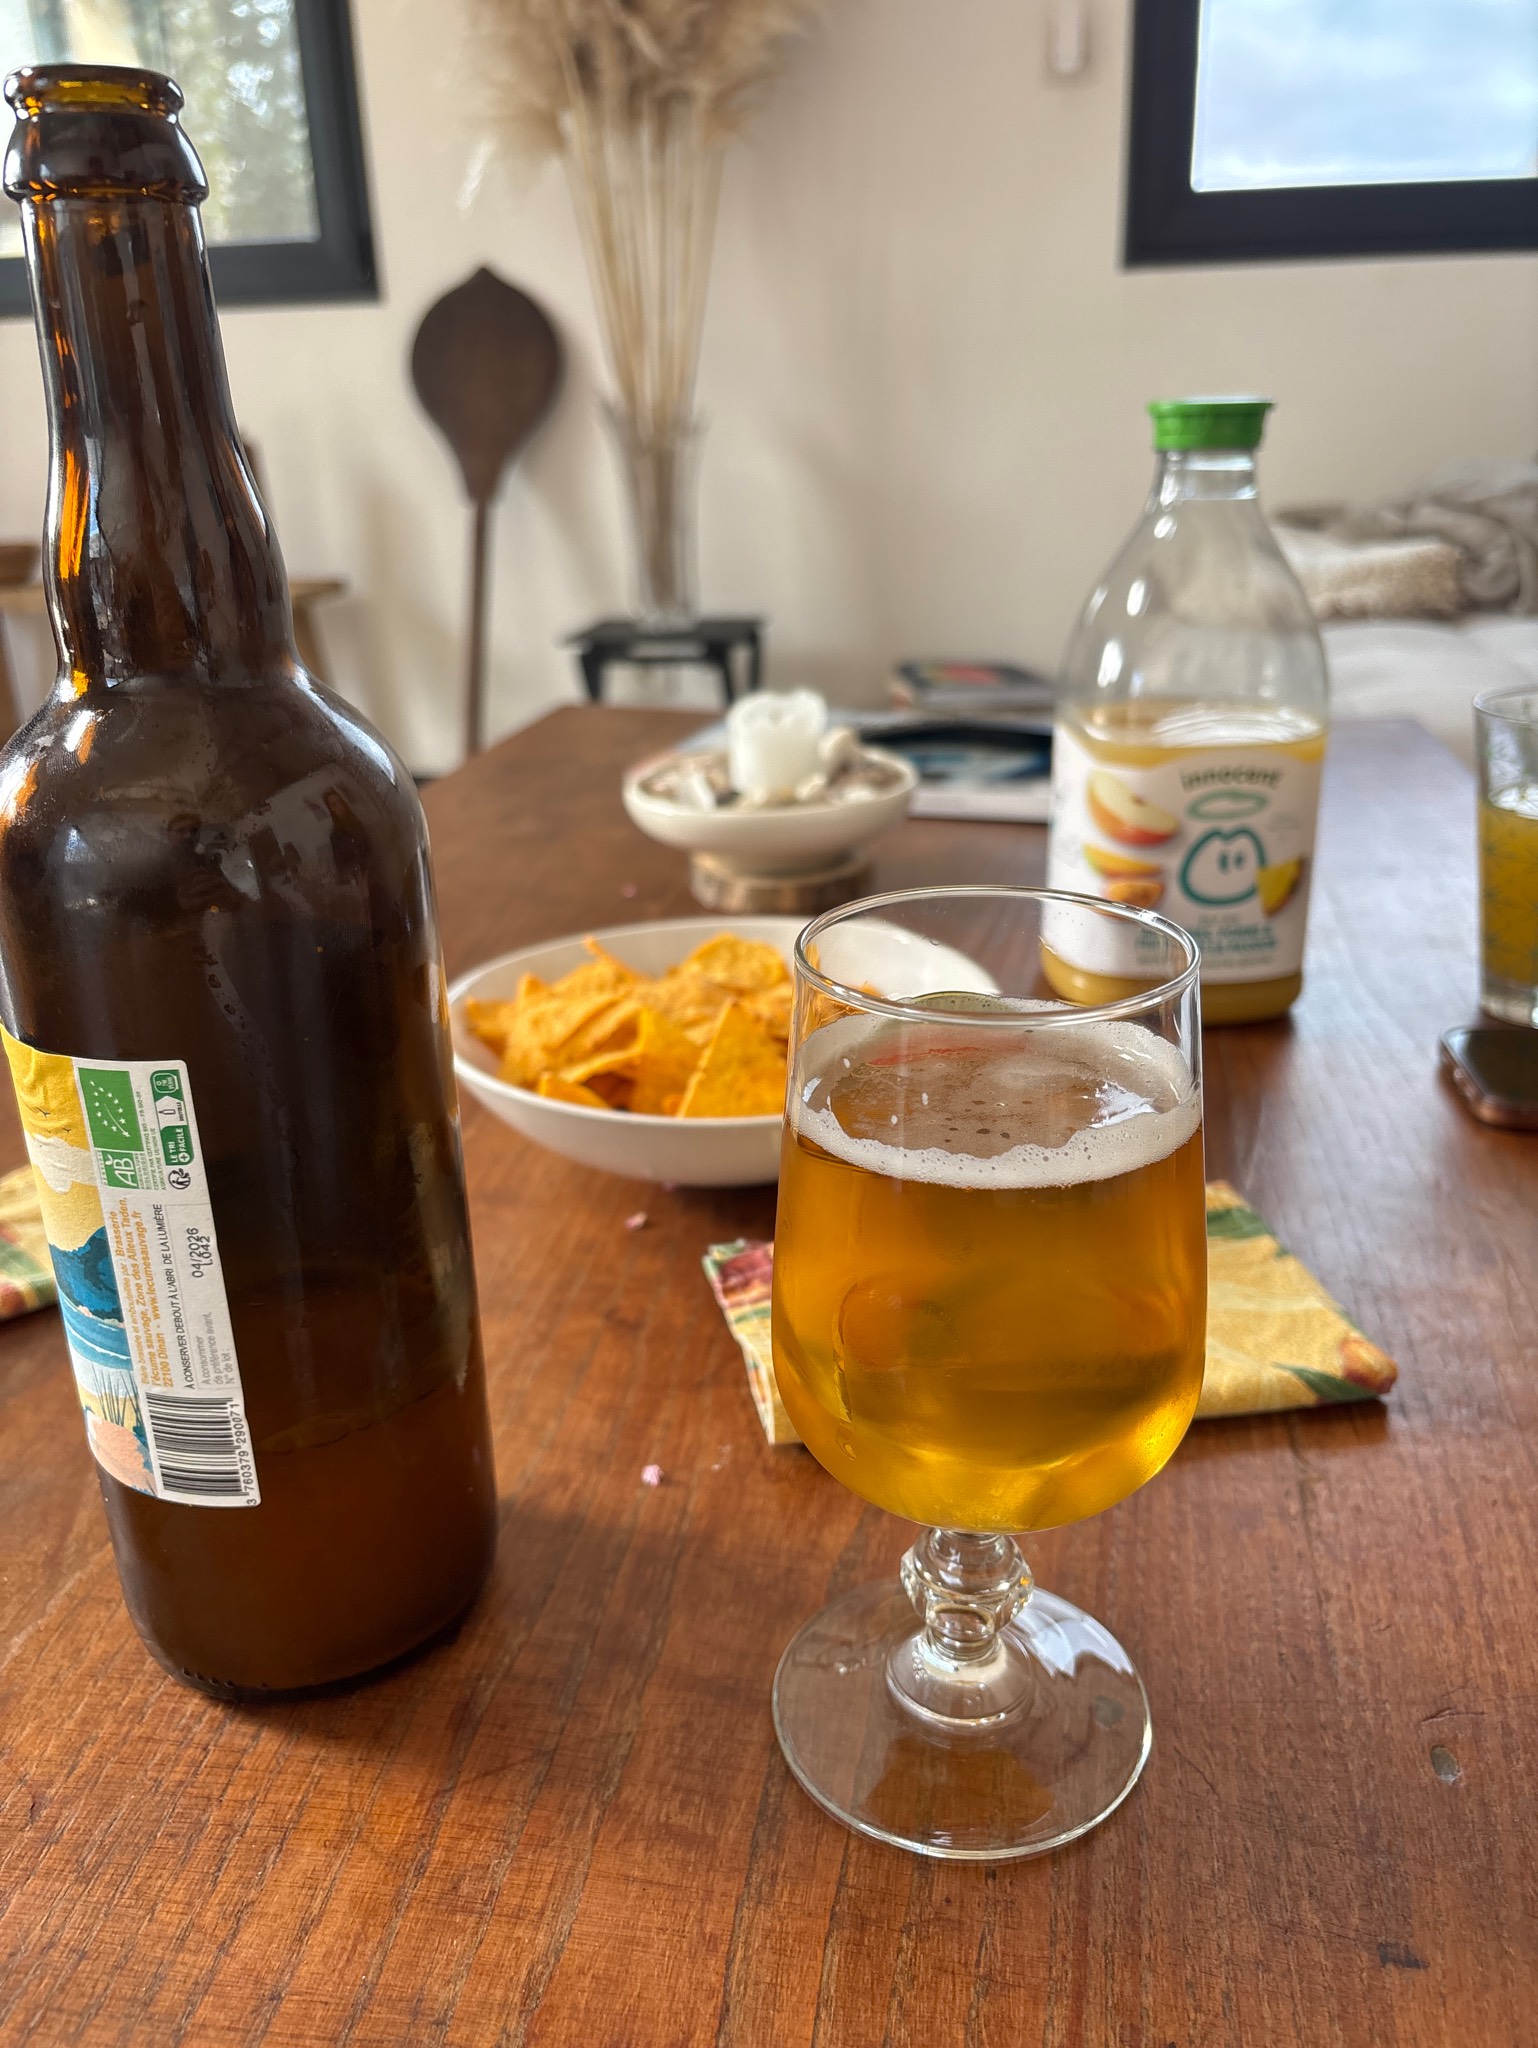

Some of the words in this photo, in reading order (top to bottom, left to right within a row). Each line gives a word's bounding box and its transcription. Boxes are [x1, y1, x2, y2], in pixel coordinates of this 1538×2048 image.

[177, 1128, 187, 1152] FACILE
[113, 1156, 137, 1186] AB
[147, 1157, 155, 1167] PAR
[170, 1154, 178, 1162] LE
[157, 1157, 166, 1190] AGRICULTURE
[118, 1198, 131, 1227] Taden,
[152, 1204, 167, 1239] LUMIÈRE
[110, 1212, 123, 1256] Brasserie
[161, 1241, 170, 1251] LA
[133, 1211, 162, 1320] www.lecumesauvage.fr
[163, 1253, 172, 1264] DE
[187, 1228, 203, 1278] 04/2026
[131, 1263, 141, 1280] des
[166, 1269, 177, 1292] L'ABRI
[135, 1283, 146, 1306] Zone
[131, 1325, 139, 1333] et
[140, 1309, 154, 1348] sauvage,
[172, 1301, 184, 1333] DEBOUT
[155, 1333, 167, 1358] Dinan
[178, 1335, 192, 1382] CONSERVER
[197, 1336, 210, 1379] consommer
[207, 1334, 222, 1373] préférence
[222, 1353, 231, 1361] lot
[161, 1361, 173, 1386] 22100
[215, 1374, 223, 1384] de
[224, 1363, 232, 1371] de
[230, 1403, 245, 1443] 290071
[239, 1451, 254, 1491] 760379
